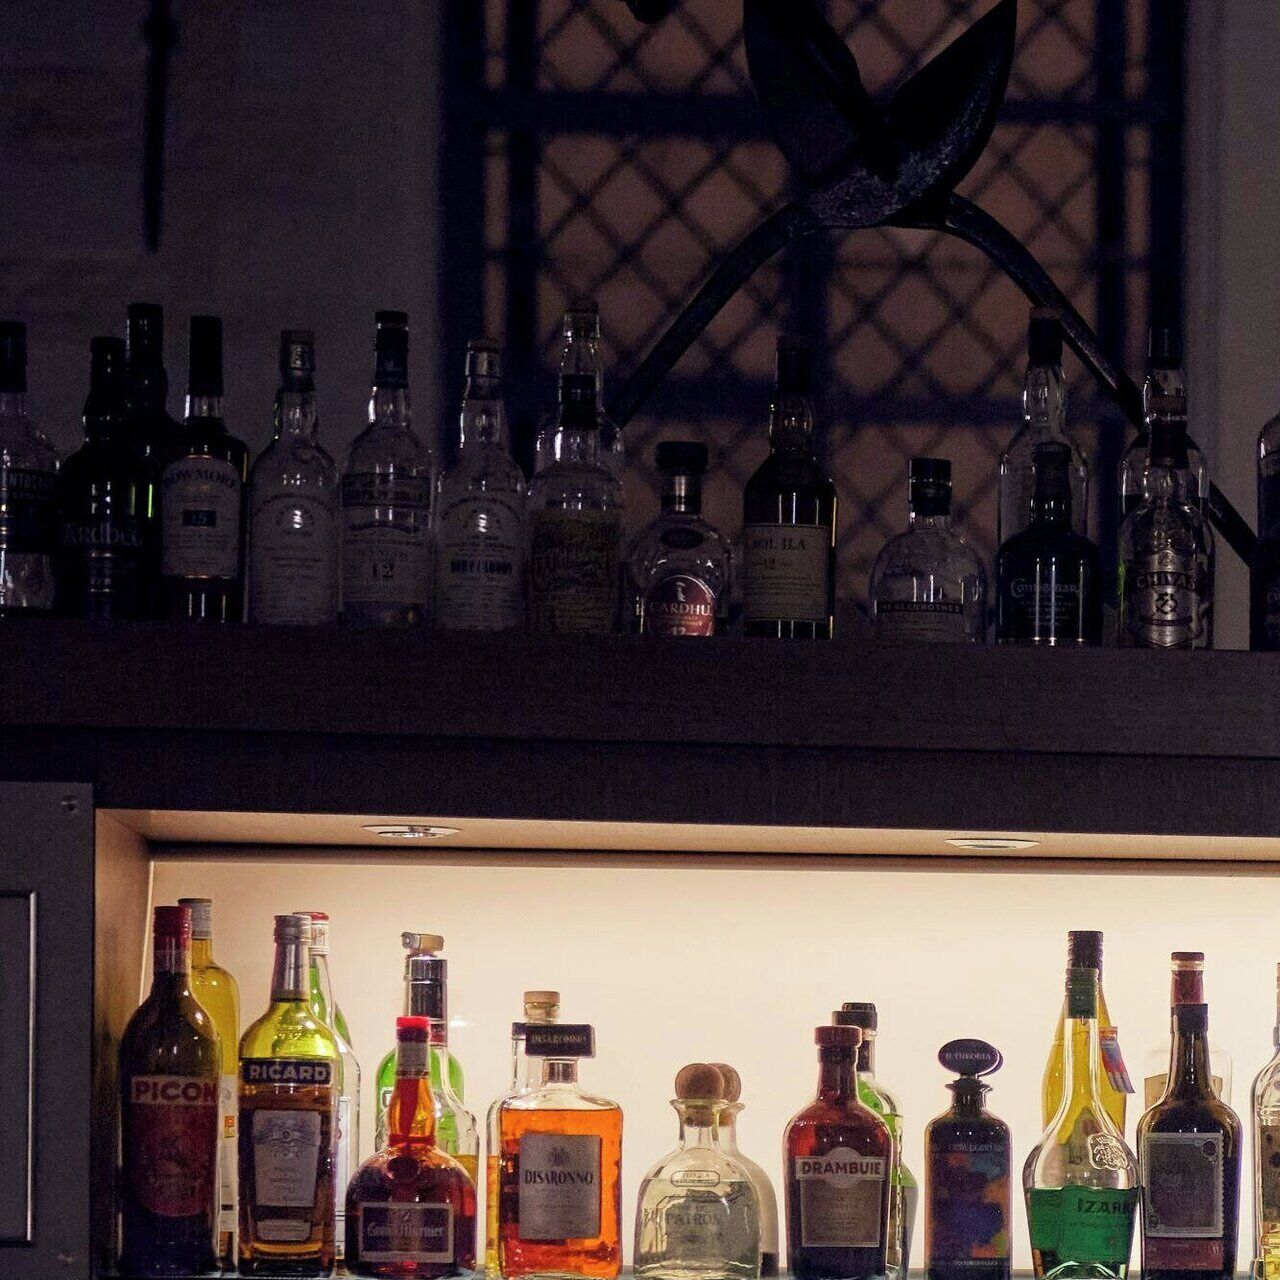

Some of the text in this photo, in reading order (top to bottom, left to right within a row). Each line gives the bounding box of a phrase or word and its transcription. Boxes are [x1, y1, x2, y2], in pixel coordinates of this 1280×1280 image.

[1135, 570, 1198, 590] CHIVAS
[649, 601, 712, 617] CARDHU
[249, 1063, 328, 1081] RICARD
[133, 1079, 218, 1103] PICON
[800, 1159, 882, 1176] DRAMBUIE
[523, 1168, 594, 1187] DISARONNO
